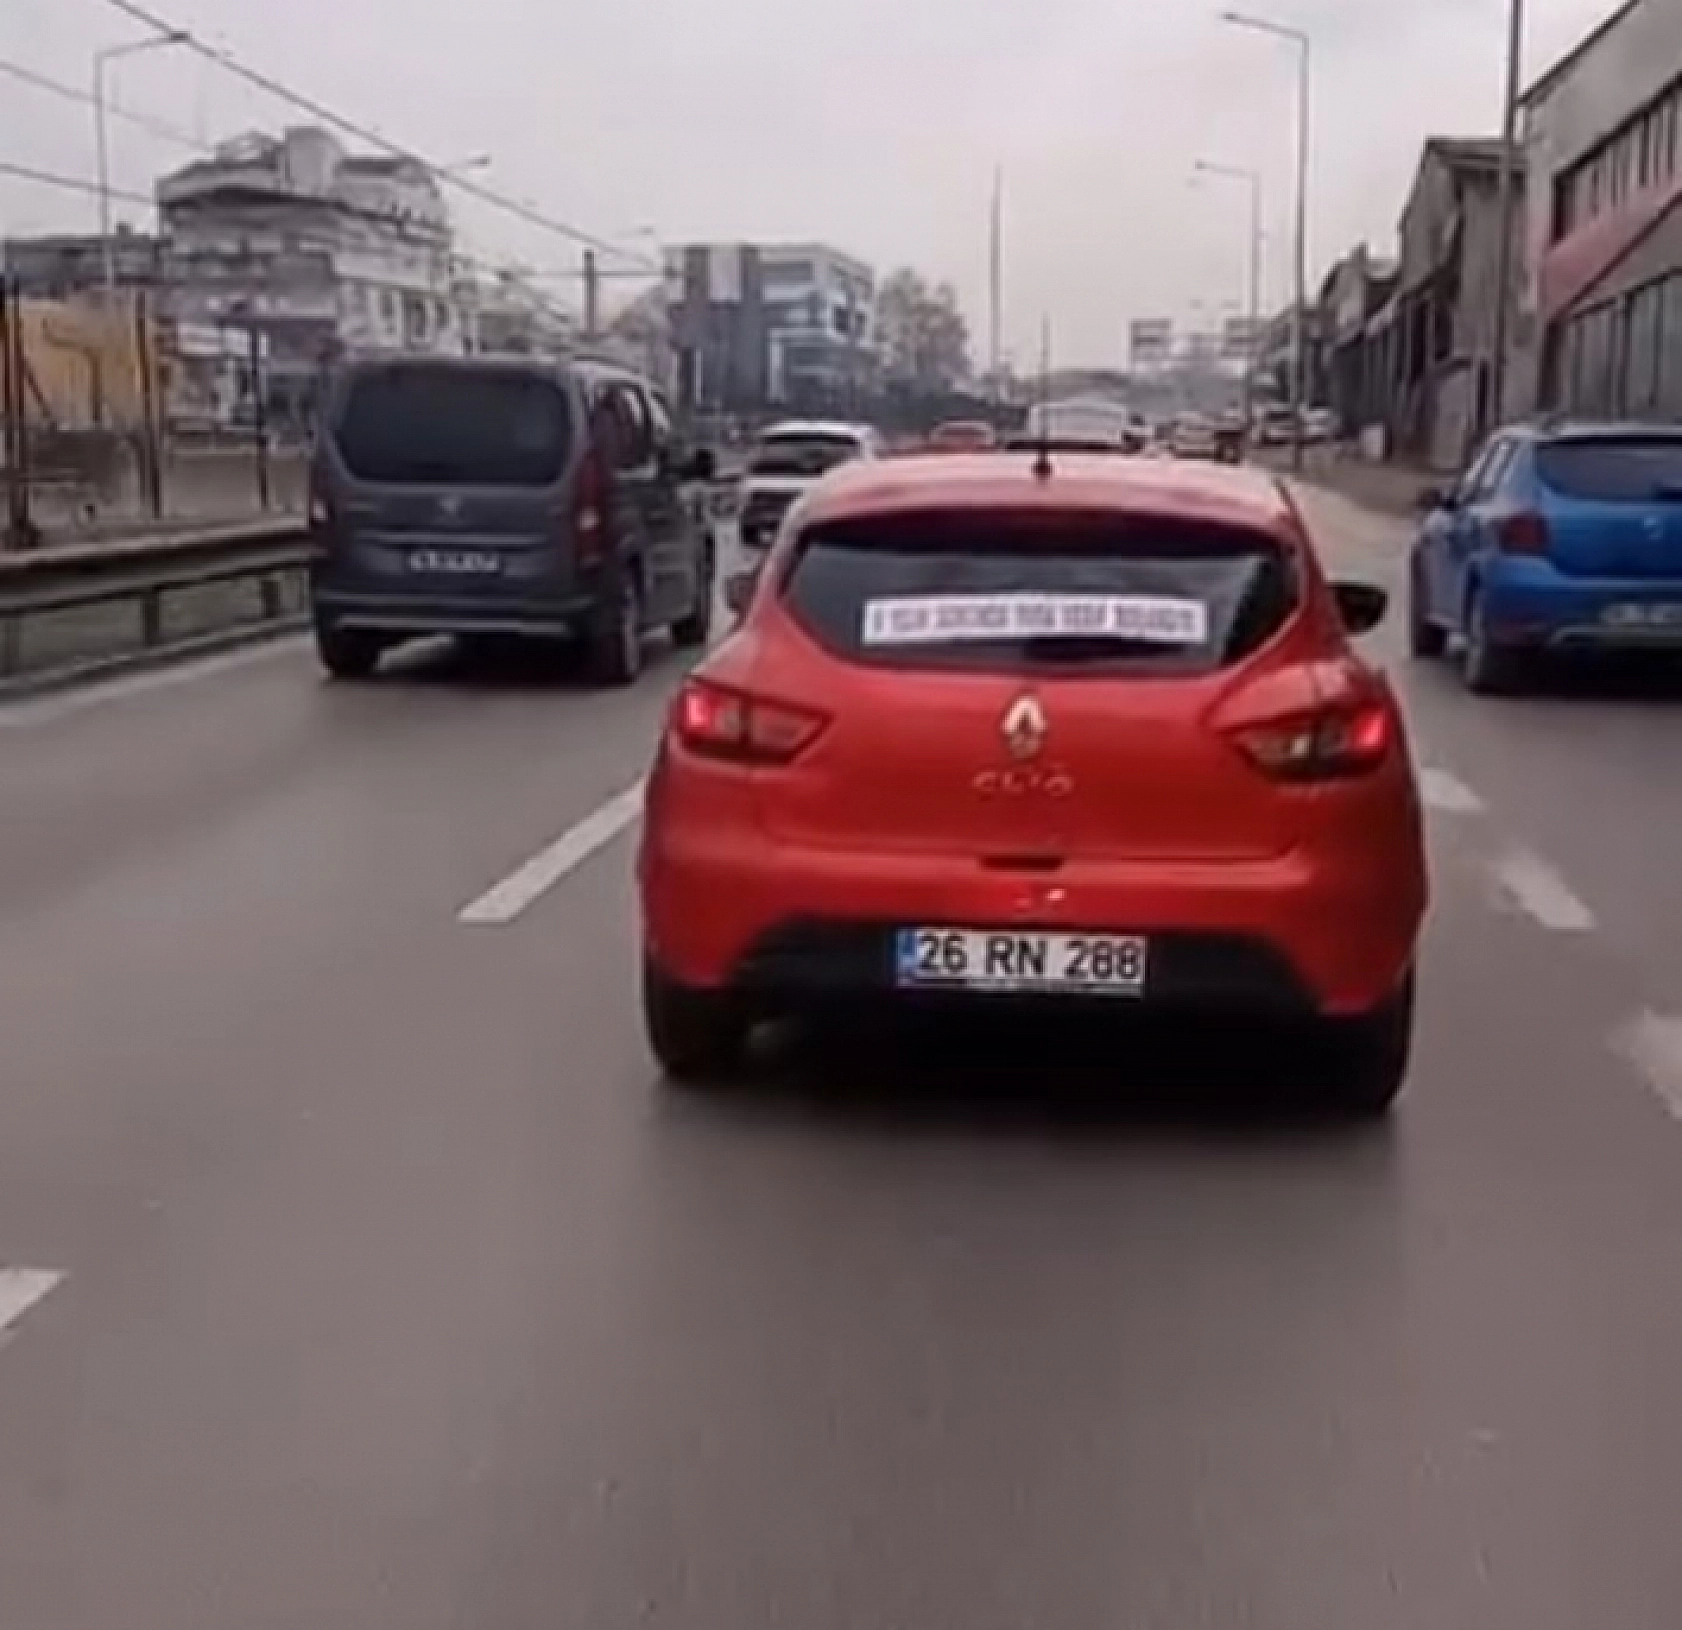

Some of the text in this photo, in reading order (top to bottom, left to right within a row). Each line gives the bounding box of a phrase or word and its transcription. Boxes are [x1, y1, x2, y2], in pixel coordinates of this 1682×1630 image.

[917, 932, 1142, 980] 26 RN 288
